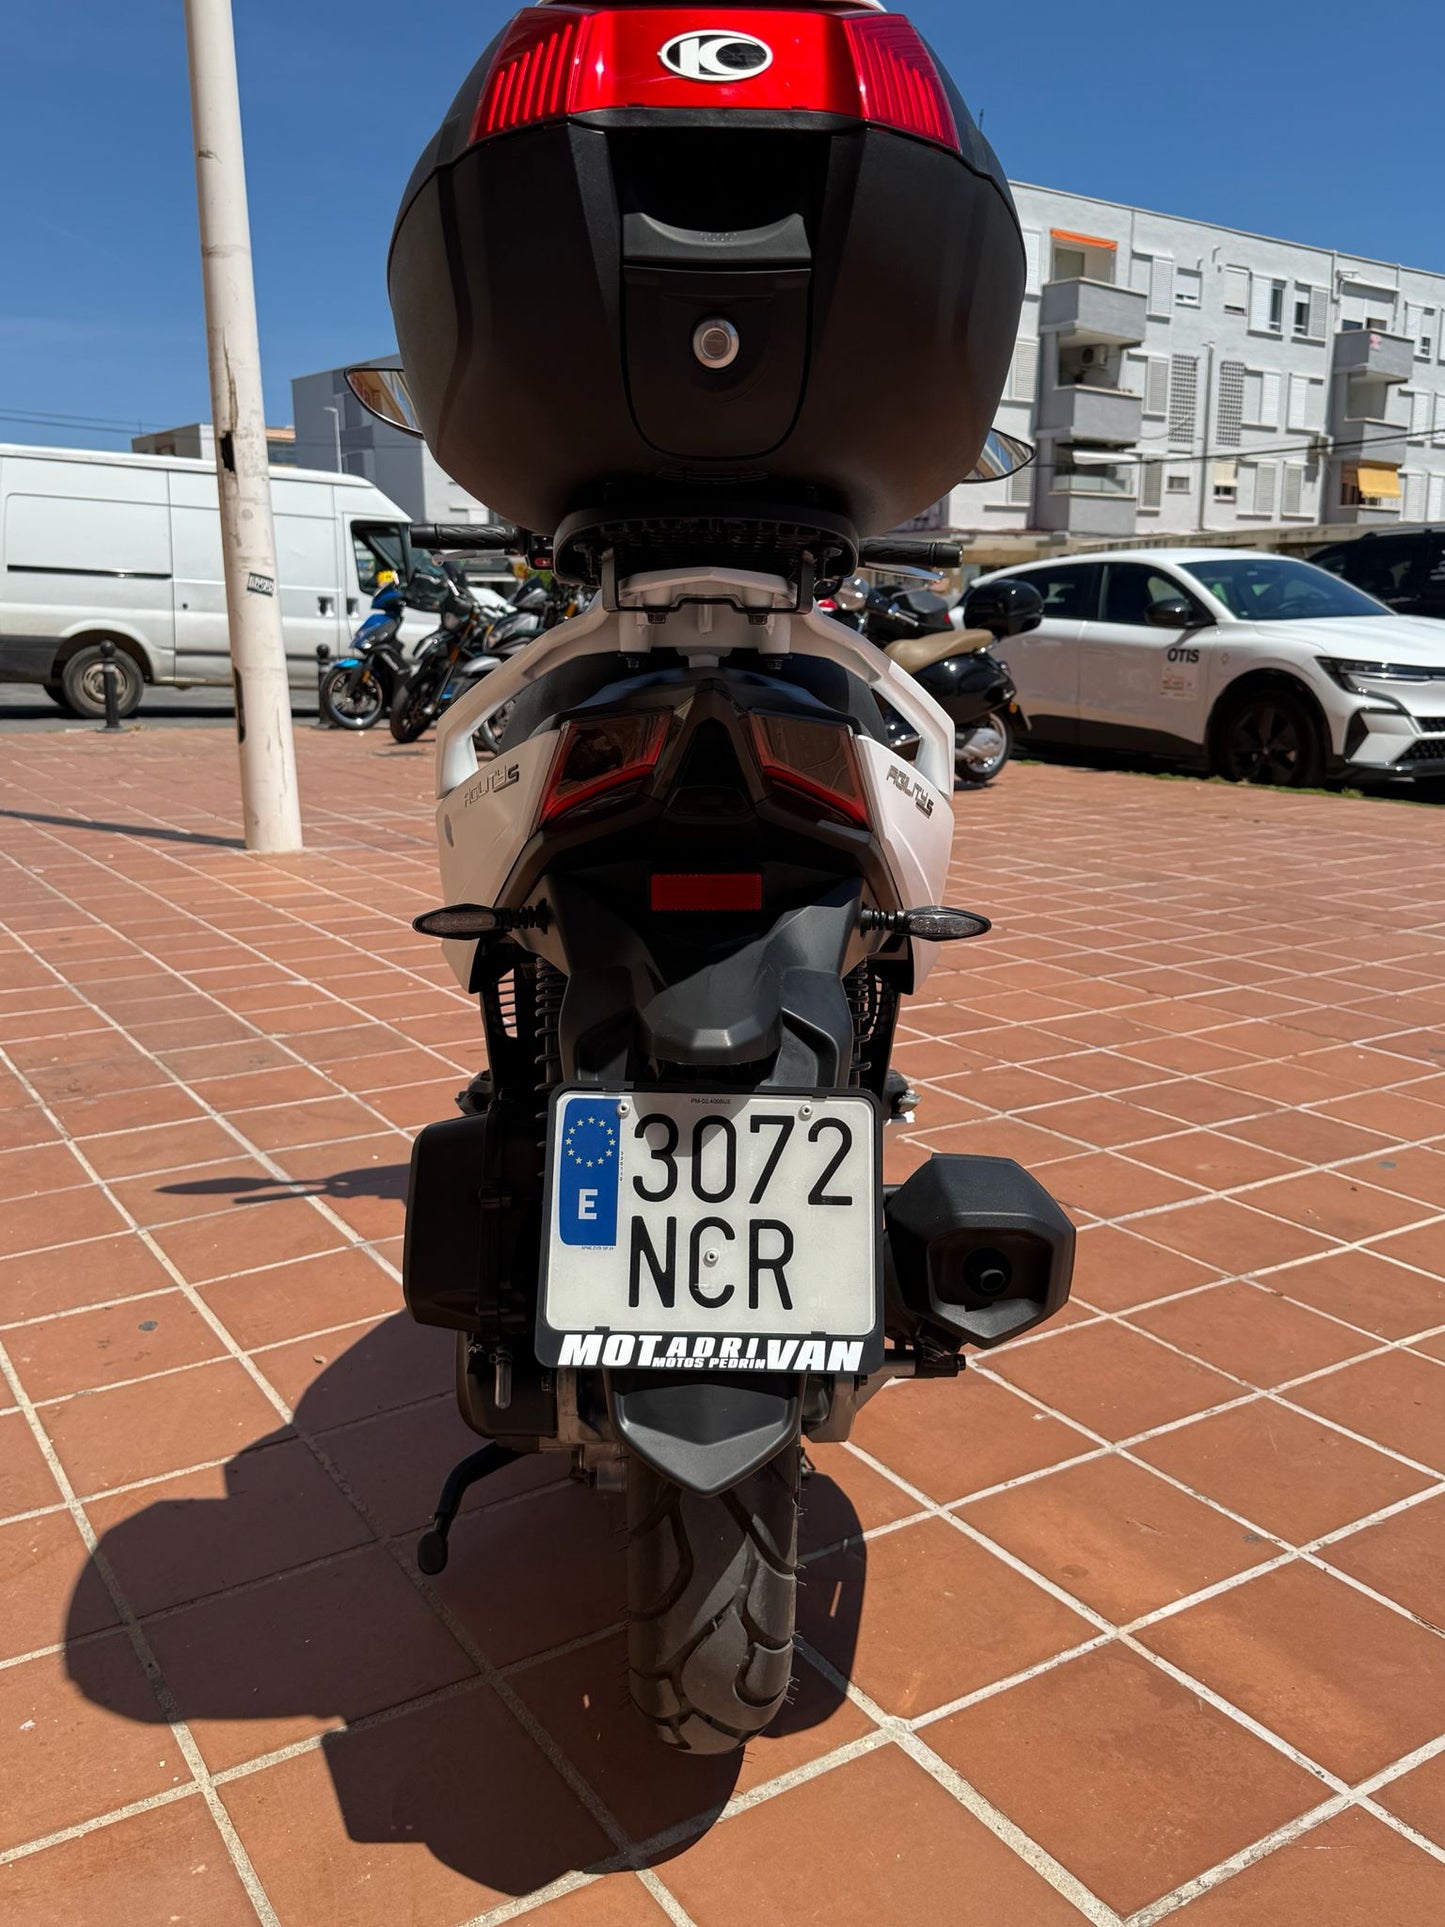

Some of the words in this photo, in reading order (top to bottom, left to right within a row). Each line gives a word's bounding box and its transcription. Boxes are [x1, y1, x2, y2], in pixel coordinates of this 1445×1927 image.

[1167, 648, 1200, 664] OTIS
[632, 1113, 853, 1206] 3072
[578, 1188, 599, 1220] E
[628, 1215, 795, 1311] NCR
[652, 1356, 704, 1368] MOTOS
[708, 1358, 766, 1369] PEDRIN
